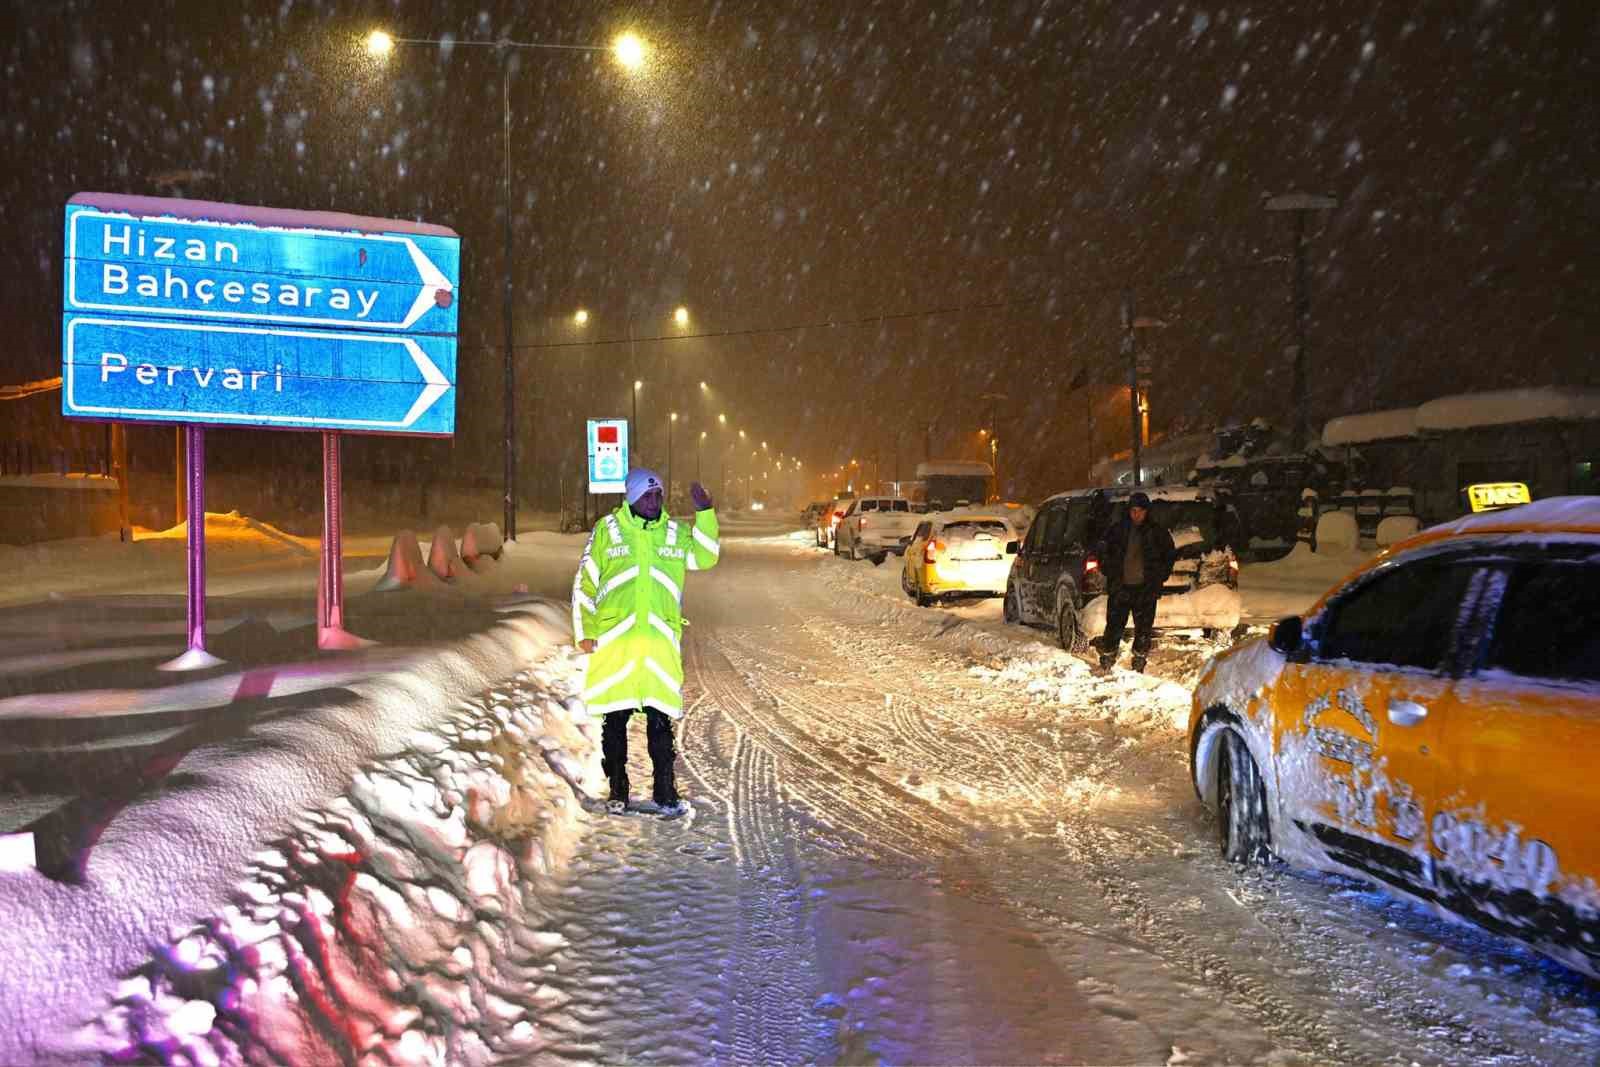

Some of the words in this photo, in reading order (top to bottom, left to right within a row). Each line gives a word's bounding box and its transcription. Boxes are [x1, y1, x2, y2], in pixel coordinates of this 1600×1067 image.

[102, 223, 240, 263] Hizan
[102, 266, 380, 318] Bahçesaray
[100, 353, 284, 392] Pervari
